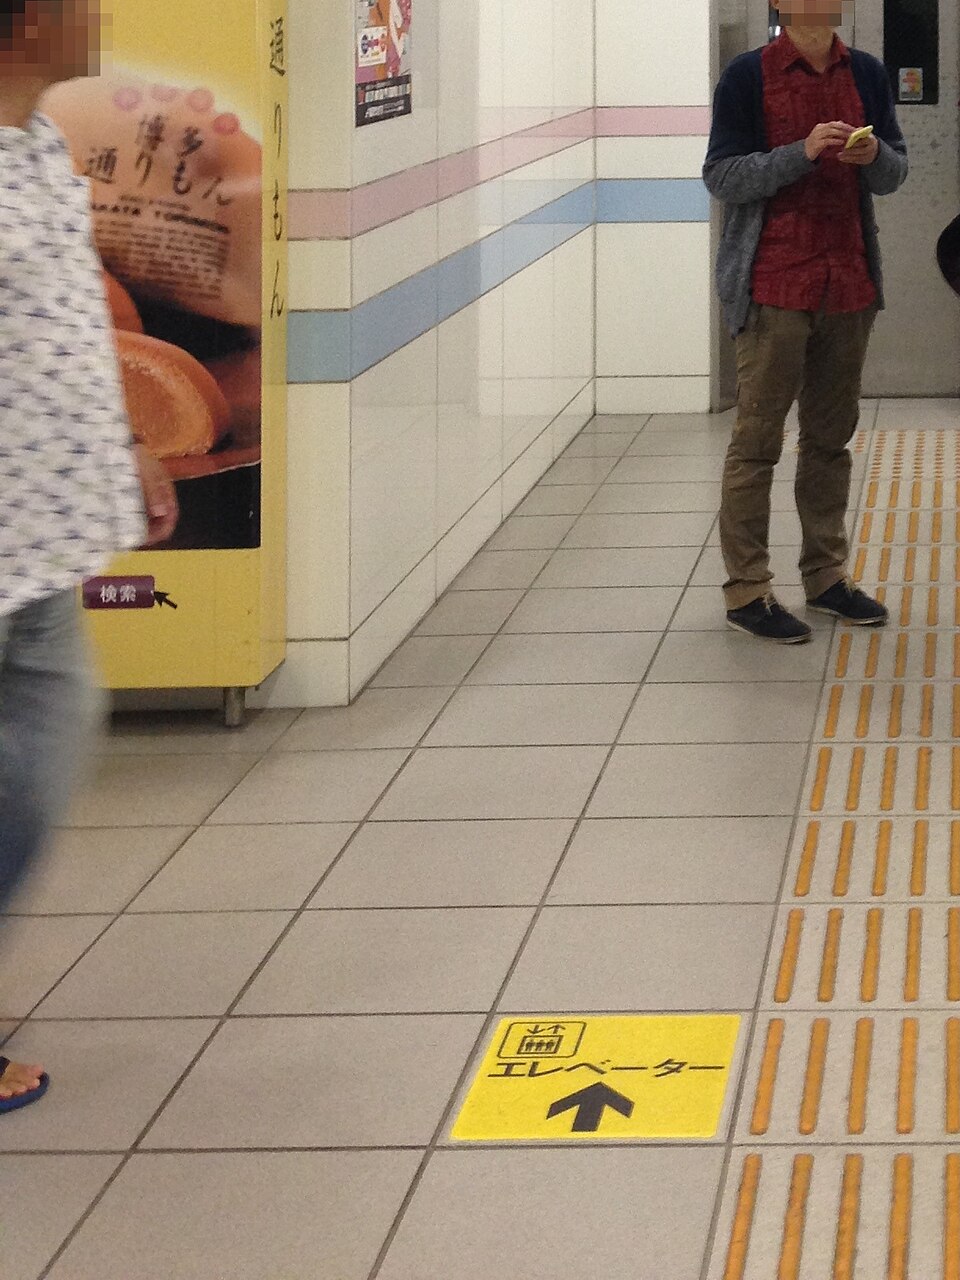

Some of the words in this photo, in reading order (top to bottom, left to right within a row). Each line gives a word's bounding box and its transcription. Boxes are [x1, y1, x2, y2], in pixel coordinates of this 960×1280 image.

[99, 584, 137, 603] 検索
[487, 1057, 726, 1079] エレベーター
